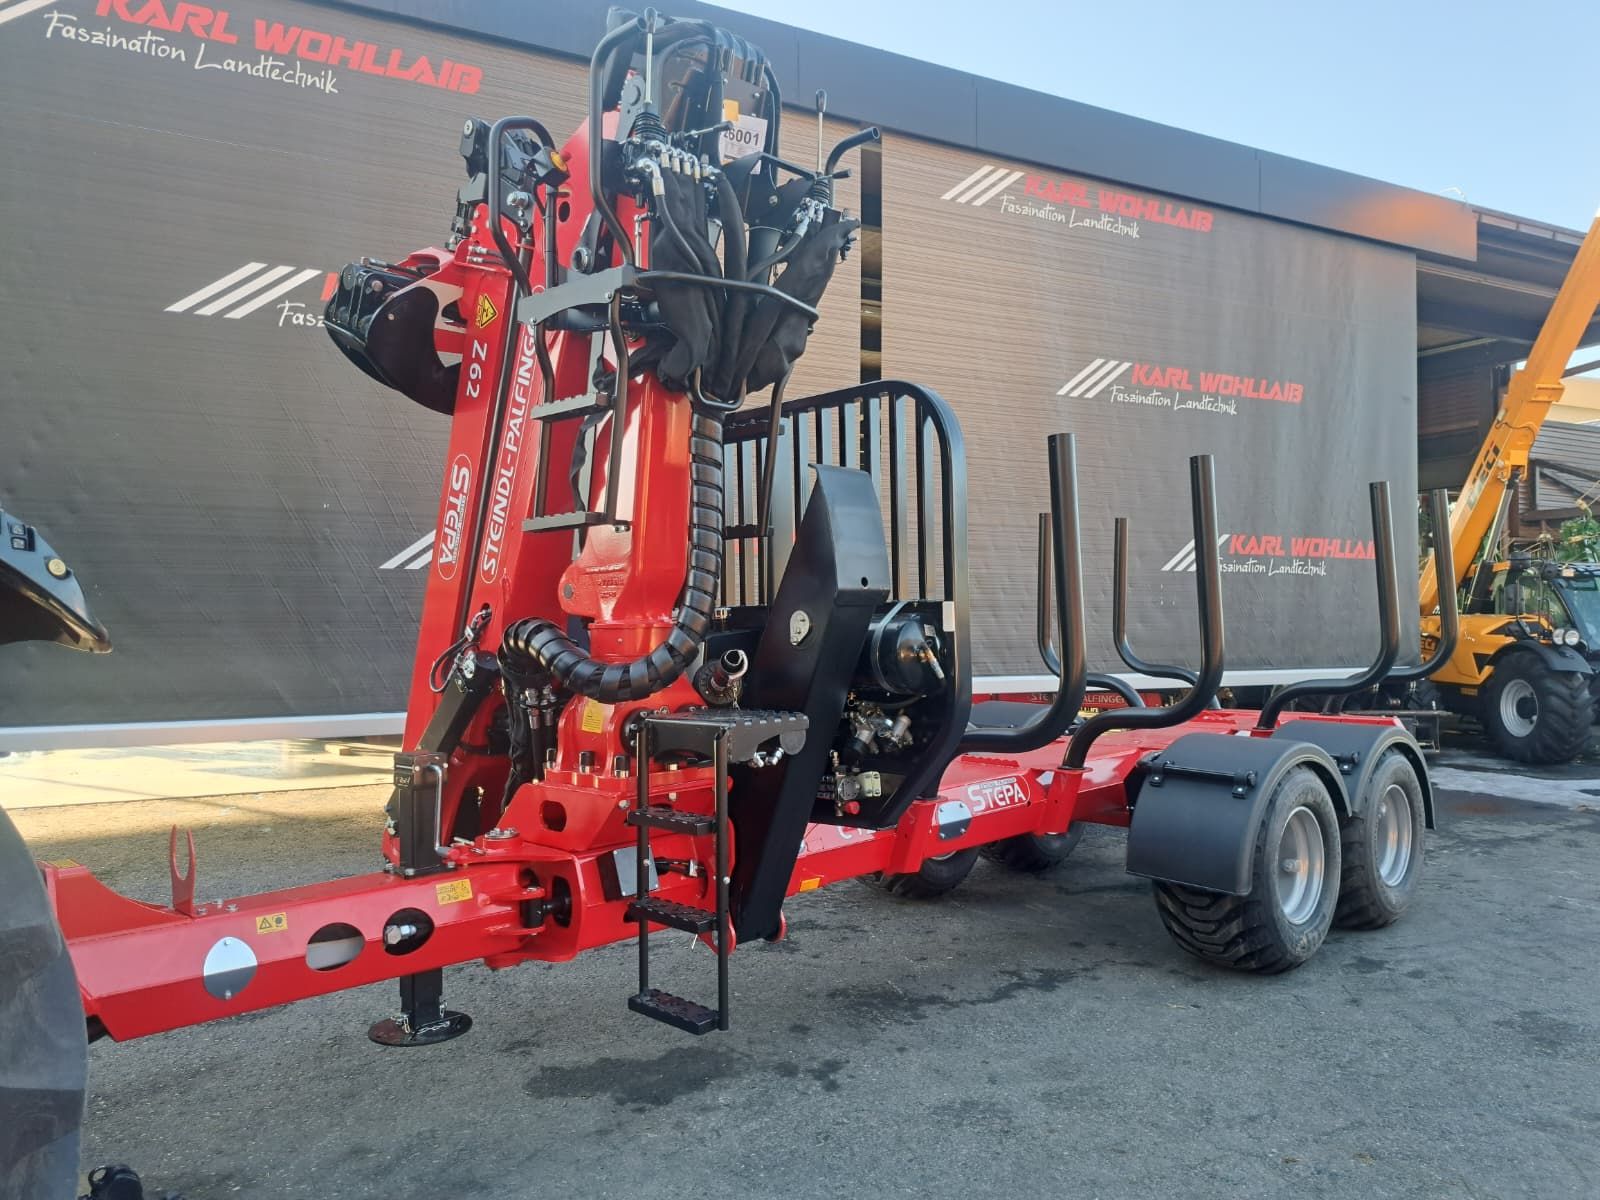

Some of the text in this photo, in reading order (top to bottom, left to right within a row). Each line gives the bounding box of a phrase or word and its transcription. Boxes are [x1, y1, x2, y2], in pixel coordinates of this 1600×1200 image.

[43, 10, 339, 94] Faszination Landtechnik
[1024, 174, 1093, 209] KARL
[999, 192, 1140, 239] Faszination Landtechnik
[1131, 363, 1193, 391] KARL
[1109, 384, 1238, 415] Faszination Landtechnik
[483, 323, 538, 576] STEINDL-PALFING
[439, 464, 471, 564] STEPA
[1229, 534, 1376, 561] KARL WOHLLAI
[1268, 558, 1327, 576] Landtechnik
[967, 781, 1026, 812] STEPA
